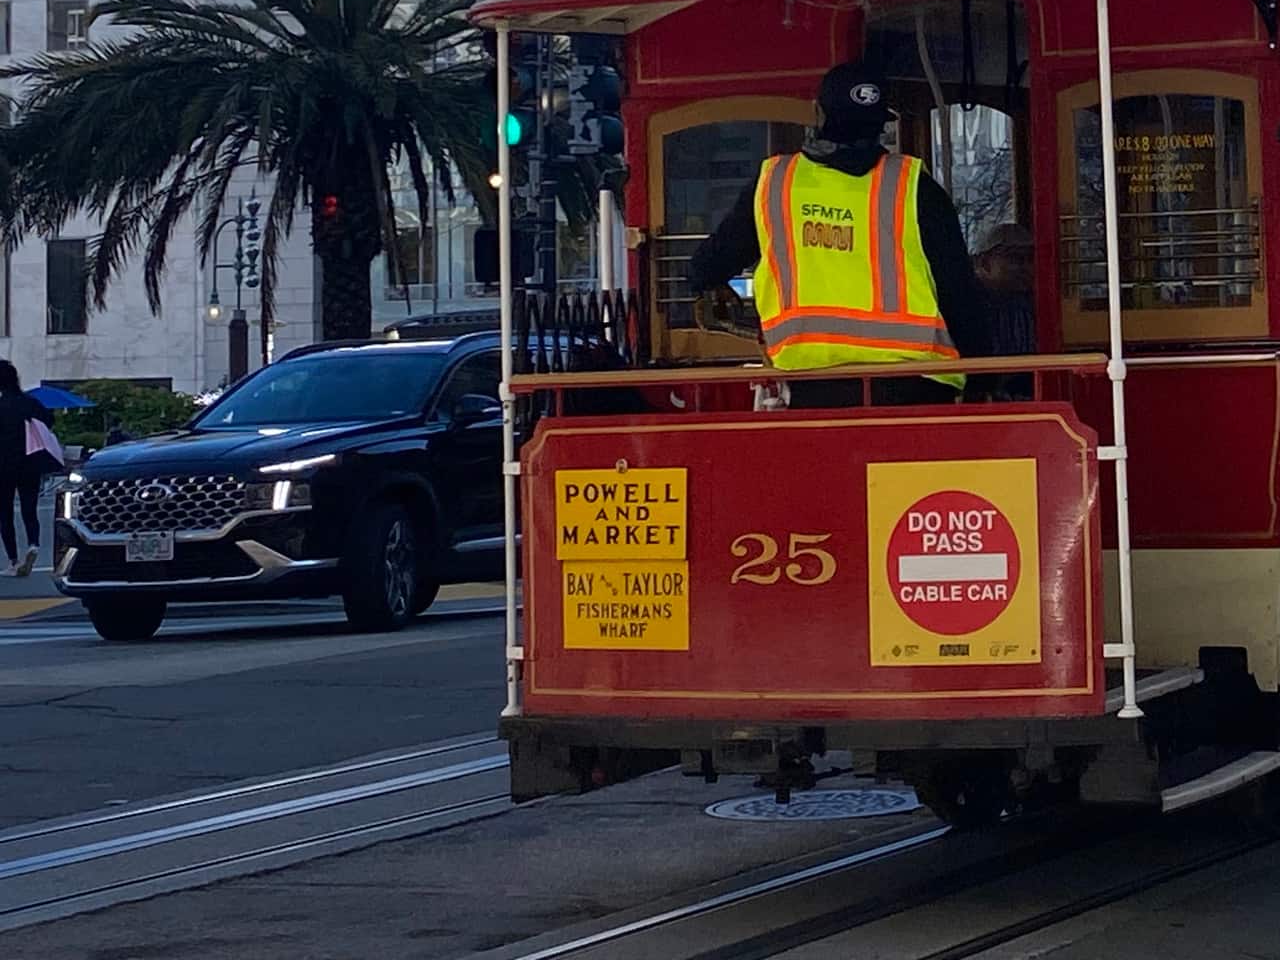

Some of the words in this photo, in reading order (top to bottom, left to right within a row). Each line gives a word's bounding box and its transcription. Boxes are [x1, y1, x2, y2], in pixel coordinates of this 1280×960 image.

[801, 203, 854, 222] SFMTA
[565, 483, 679, 503] POWELL
[595, 506, 650, 521] AND
[907, 511, 942, 532] DO
[949, 510, 997, 531] NOT
[562, 525, 681, 545] MARKET
[922, 532, 984, 553] PASS
[730, 532, 838, 586] 25
[567, 572, 594, 596] BAY
[622, 572, 684, 596] TAYLOR
[900, 585, 963, 603] CABLE
[967, 583, 1008, 601] CAR
[576, 602, 673, 619] FISHERMANS
[599, 622, 648, 639] WHARF
